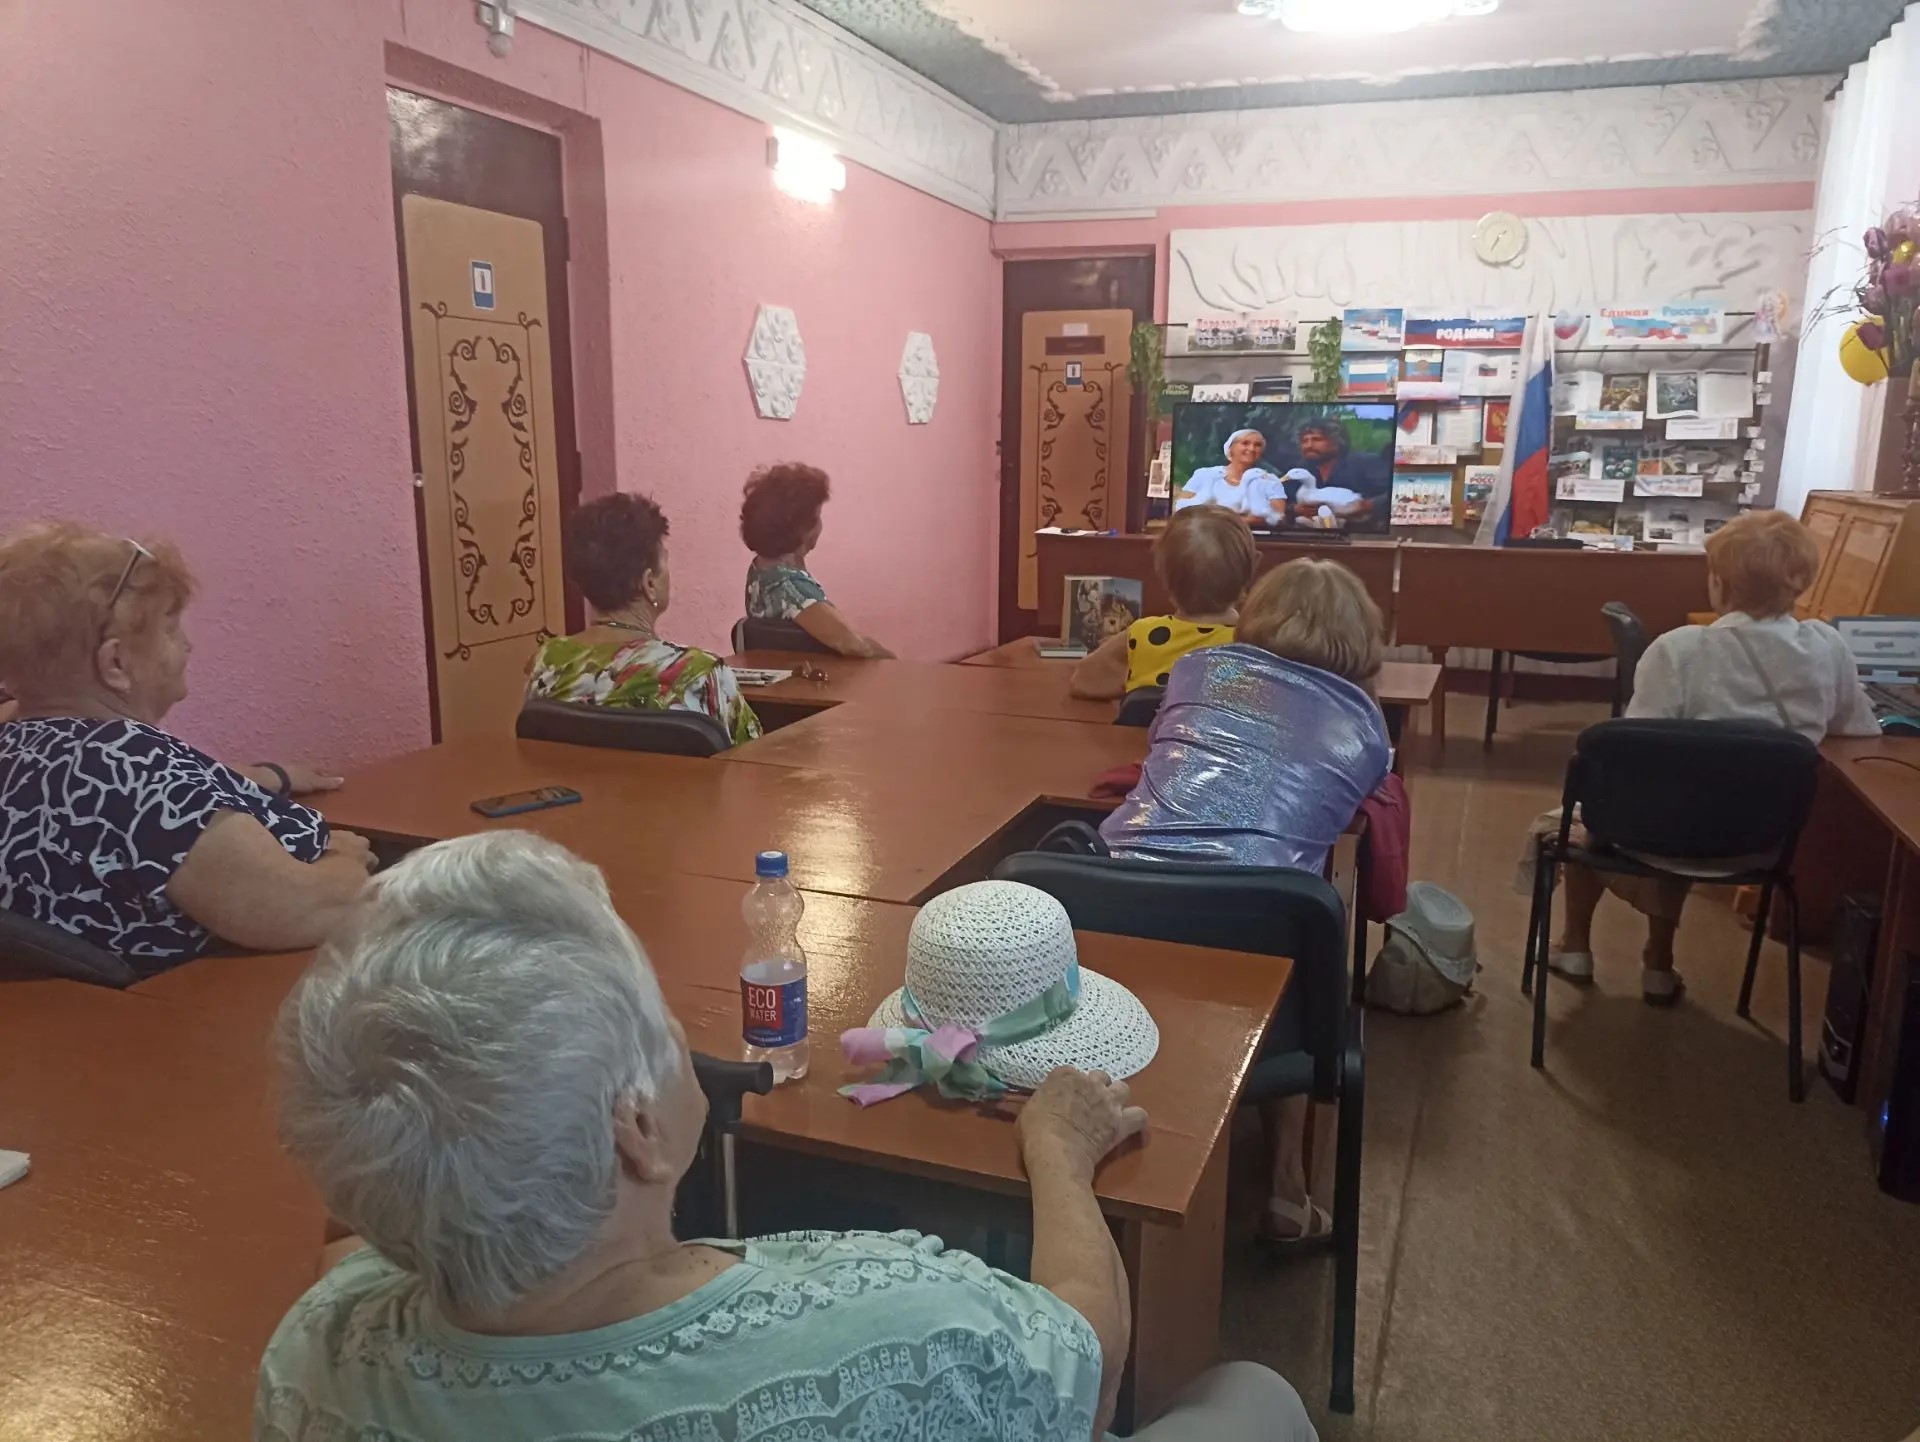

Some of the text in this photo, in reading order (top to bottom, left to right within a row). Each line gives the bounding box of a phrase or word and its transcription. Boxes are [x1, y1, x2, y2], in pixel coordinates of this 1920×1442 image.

[1436, 328, 1495, 341] РОДИНЫ
[748, 986, 776, 1009] ECO
[750, 1008, 777, 1022] WATER
